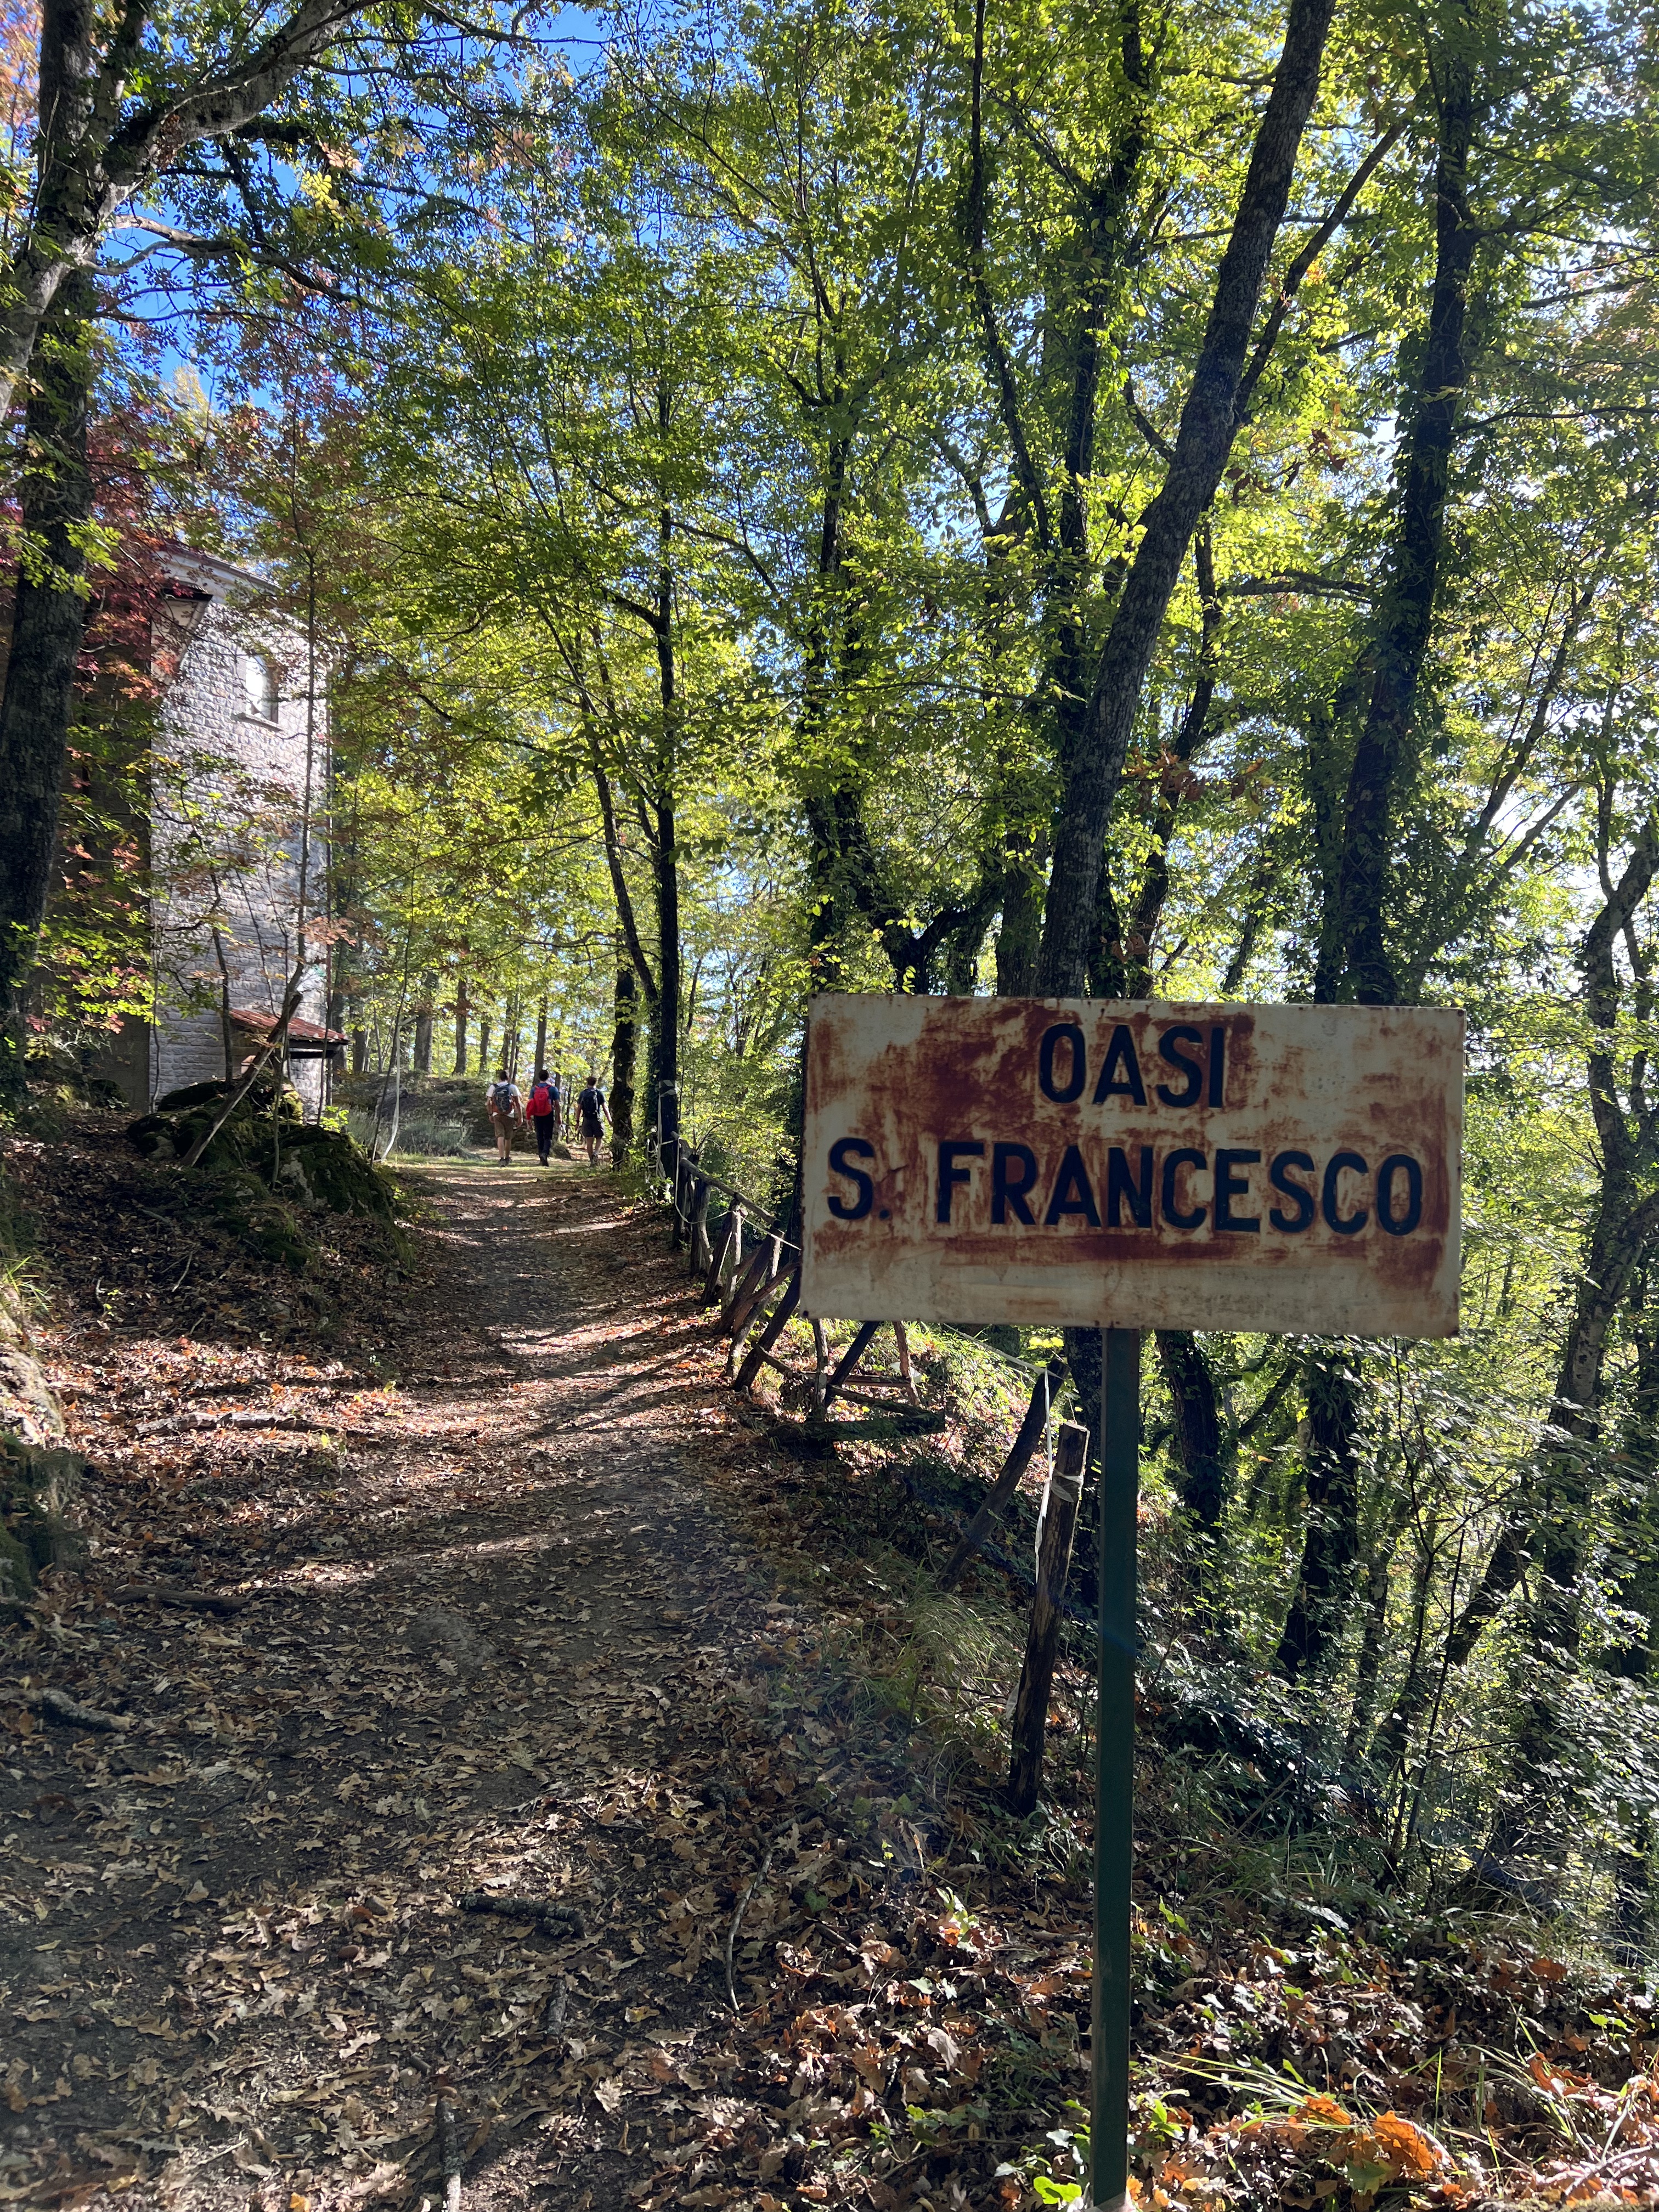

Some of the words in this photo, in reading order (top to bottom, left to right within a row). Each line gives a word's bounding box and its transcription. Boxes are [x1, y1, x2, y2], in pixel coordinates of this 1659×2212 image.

[1039, 1023, 1225, 1108] OASI
[827, 1137, 891, 1220] S.
[938, 1141, 1423, 1236] FRANCESCO
